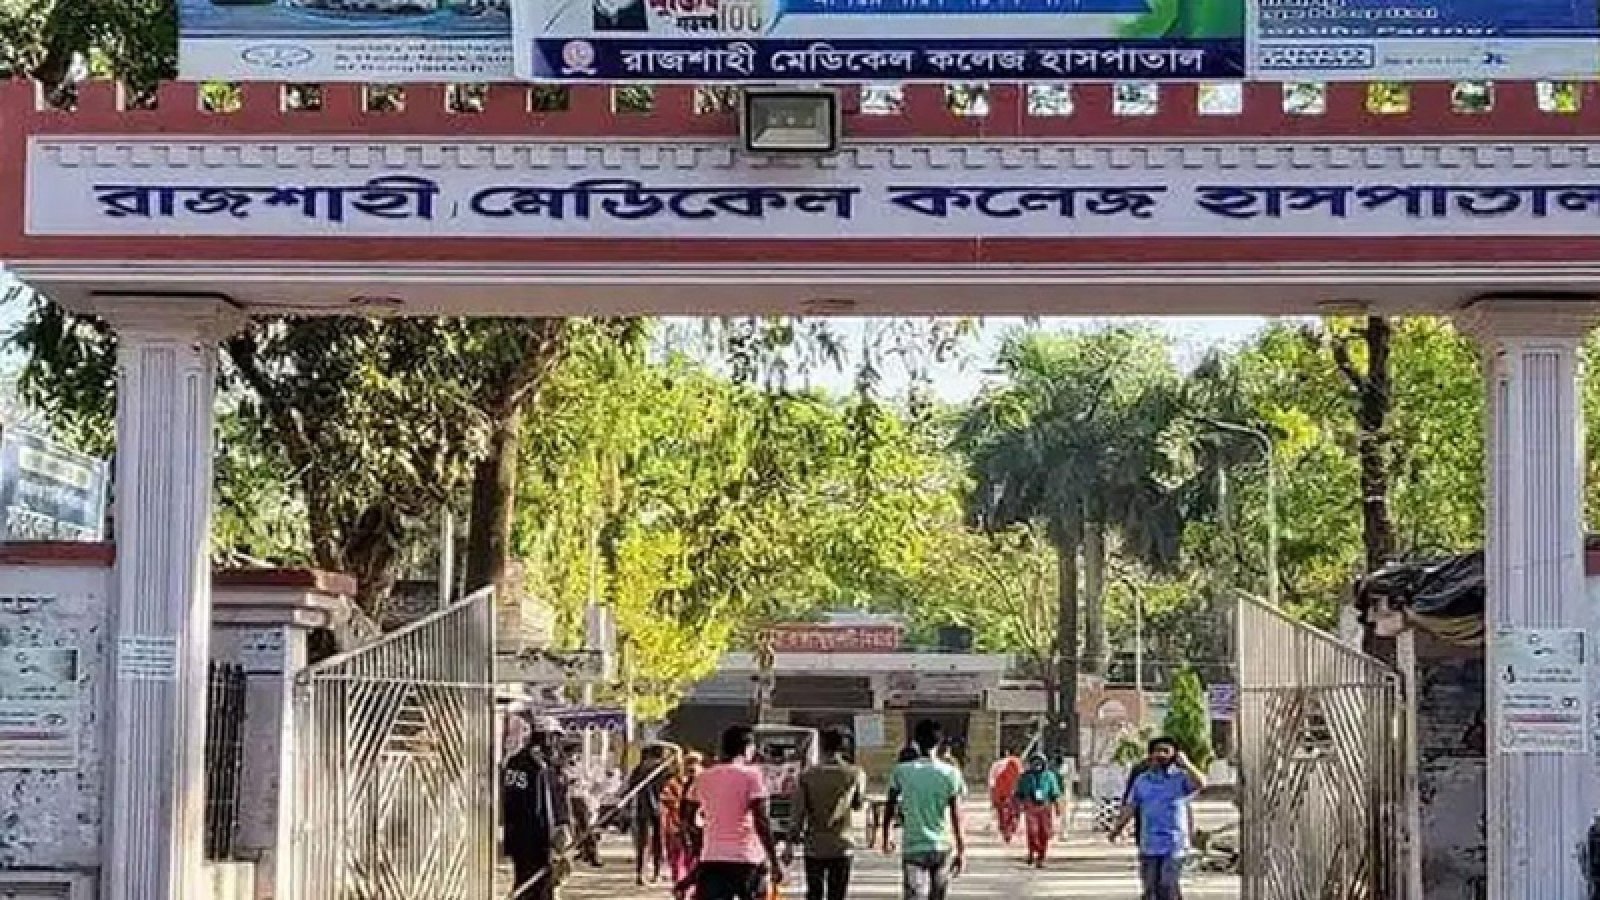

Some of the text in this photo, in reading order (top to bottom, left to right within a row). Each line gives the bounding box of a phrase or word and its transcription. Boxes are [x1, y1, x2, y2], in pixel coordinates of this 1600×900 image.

[620, 41, 1205, 75] রাজশাহী মেডিকেল কলেজ হাসপাতাল
[93, 175, 440, 222] রাজশাহী
[470, 178, 861, 219] মেডিকেল
[887, 185, 1167, 218] কলেজ
